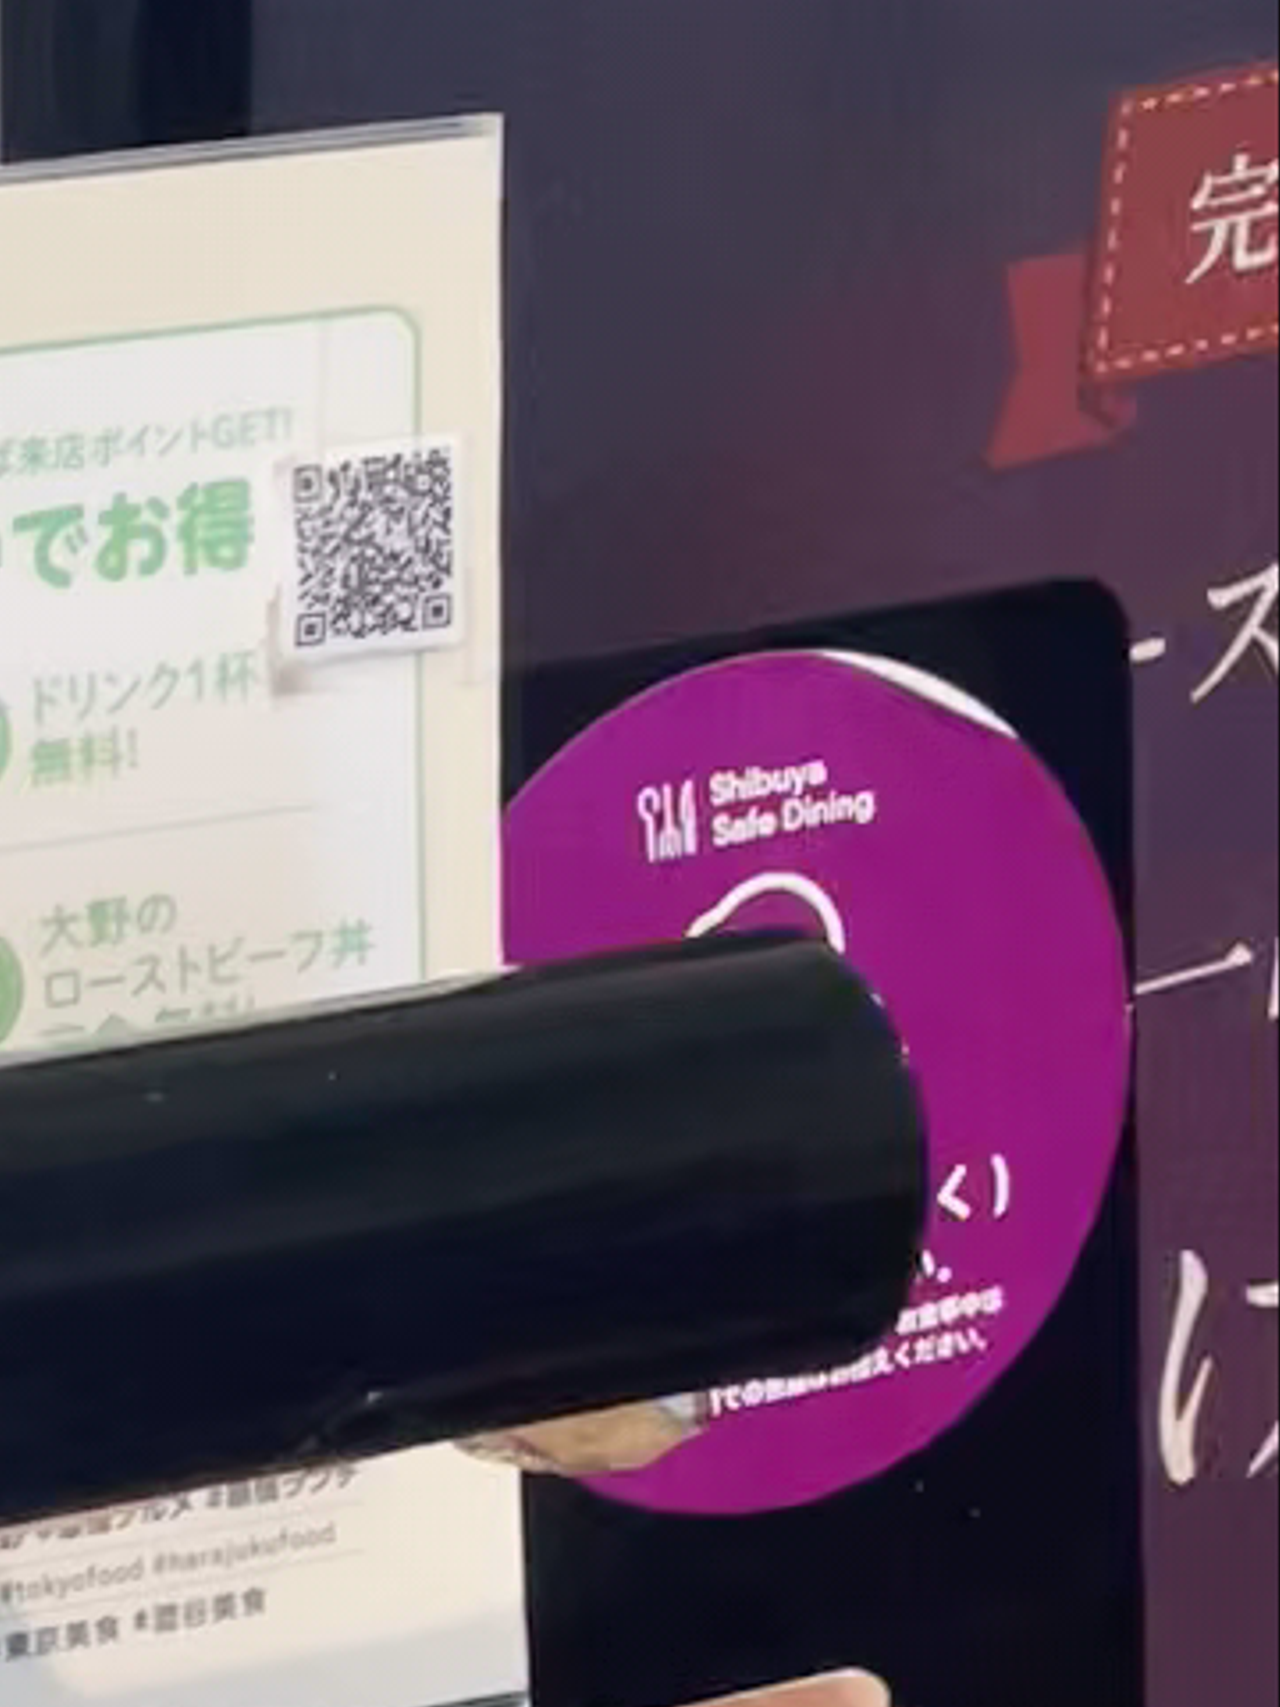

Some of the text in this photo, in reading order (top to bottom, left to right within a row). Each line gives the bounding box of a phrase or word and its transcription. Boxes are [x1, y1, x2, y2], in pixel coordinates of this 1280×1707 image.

[710, 761, 828, 807] Shibuya
[712, 791, 876, 847] Safe Dining
[41, 892, 178, 957] 大野の
